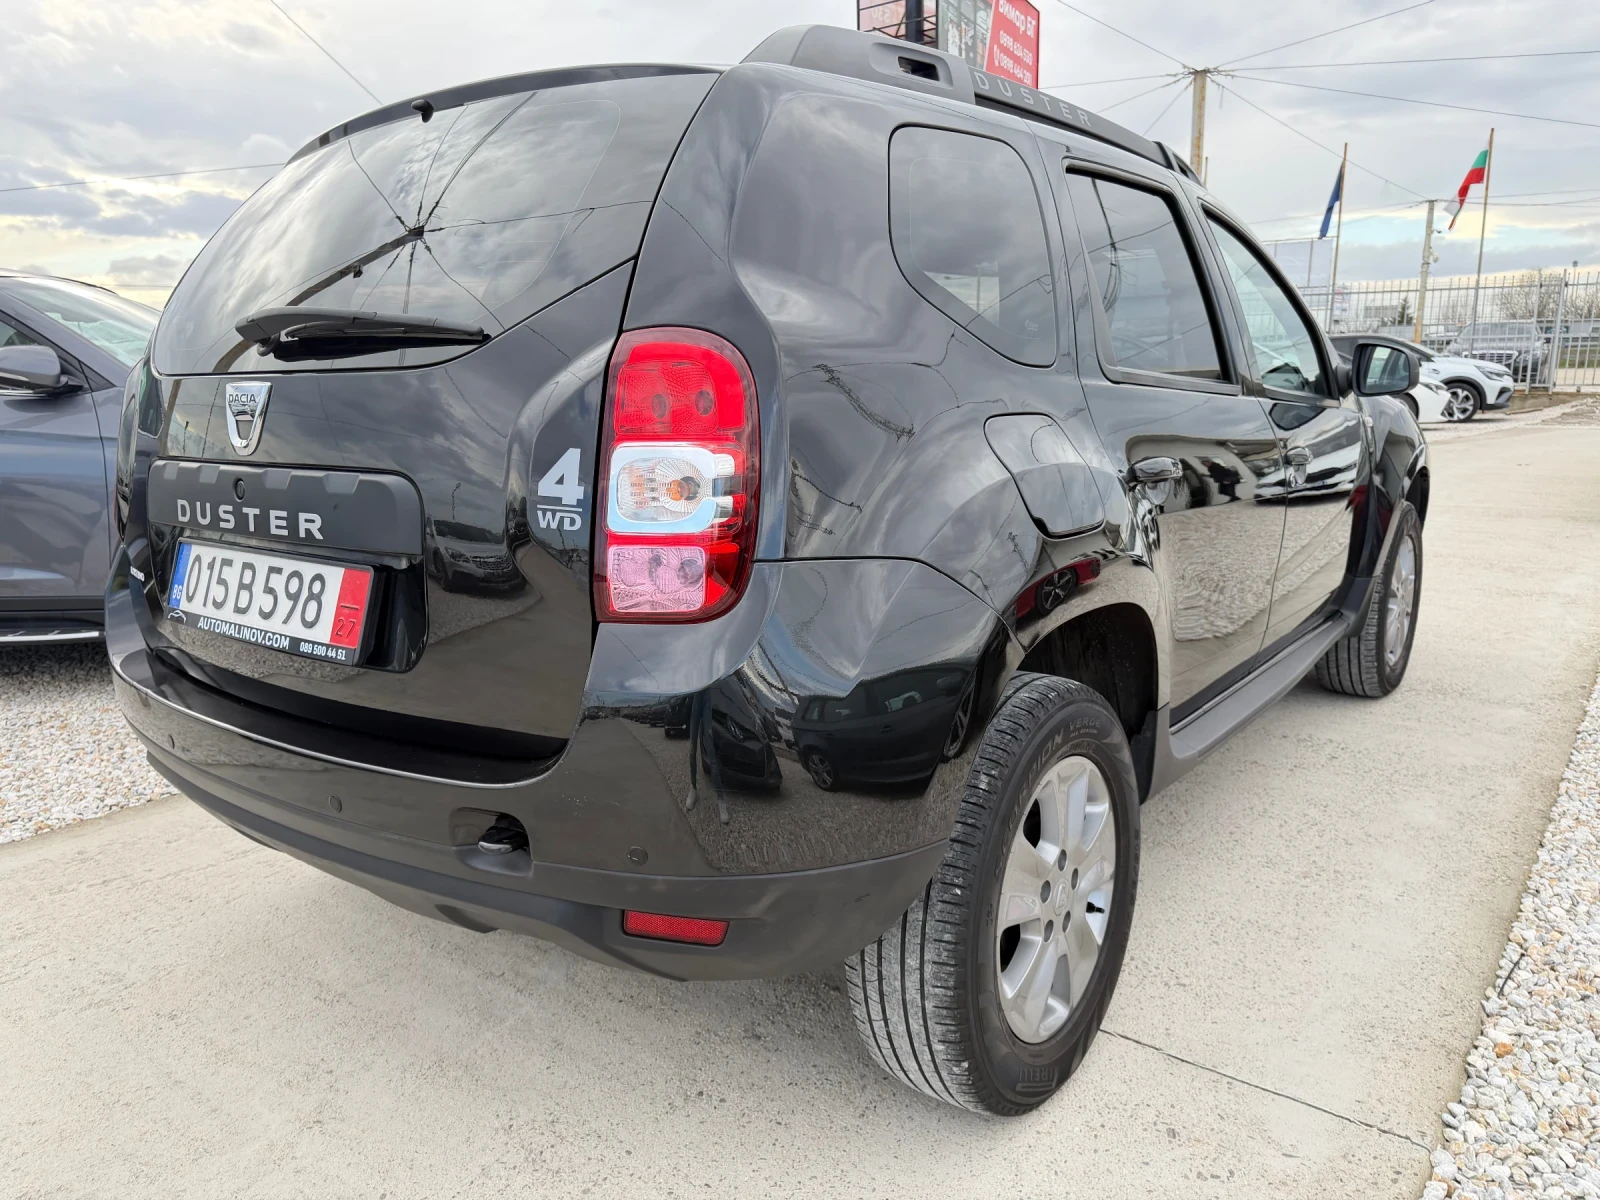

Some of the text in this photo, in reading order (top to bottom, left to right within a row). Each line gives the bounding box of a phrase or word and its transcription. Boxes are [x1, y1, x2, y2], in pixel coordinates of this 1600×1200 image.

[975, 72, 1092, 127] DUSTER
[228, 393, 257, 405] DACIA
[537, 447, 585, 505] 4
[176, 499, 324, 540] DUSTER
[537, 511, 582, 531] WD
[172, 584, 182, 599] BG
[198, 616, 346, 660] AUTOMALINOV.COM 089 500 44 51
[334, 618, 356, 639] 27
[1069, 717, 1101, 731] VERDE
[1015, 1067, 1059, 1092] PIRELLI
